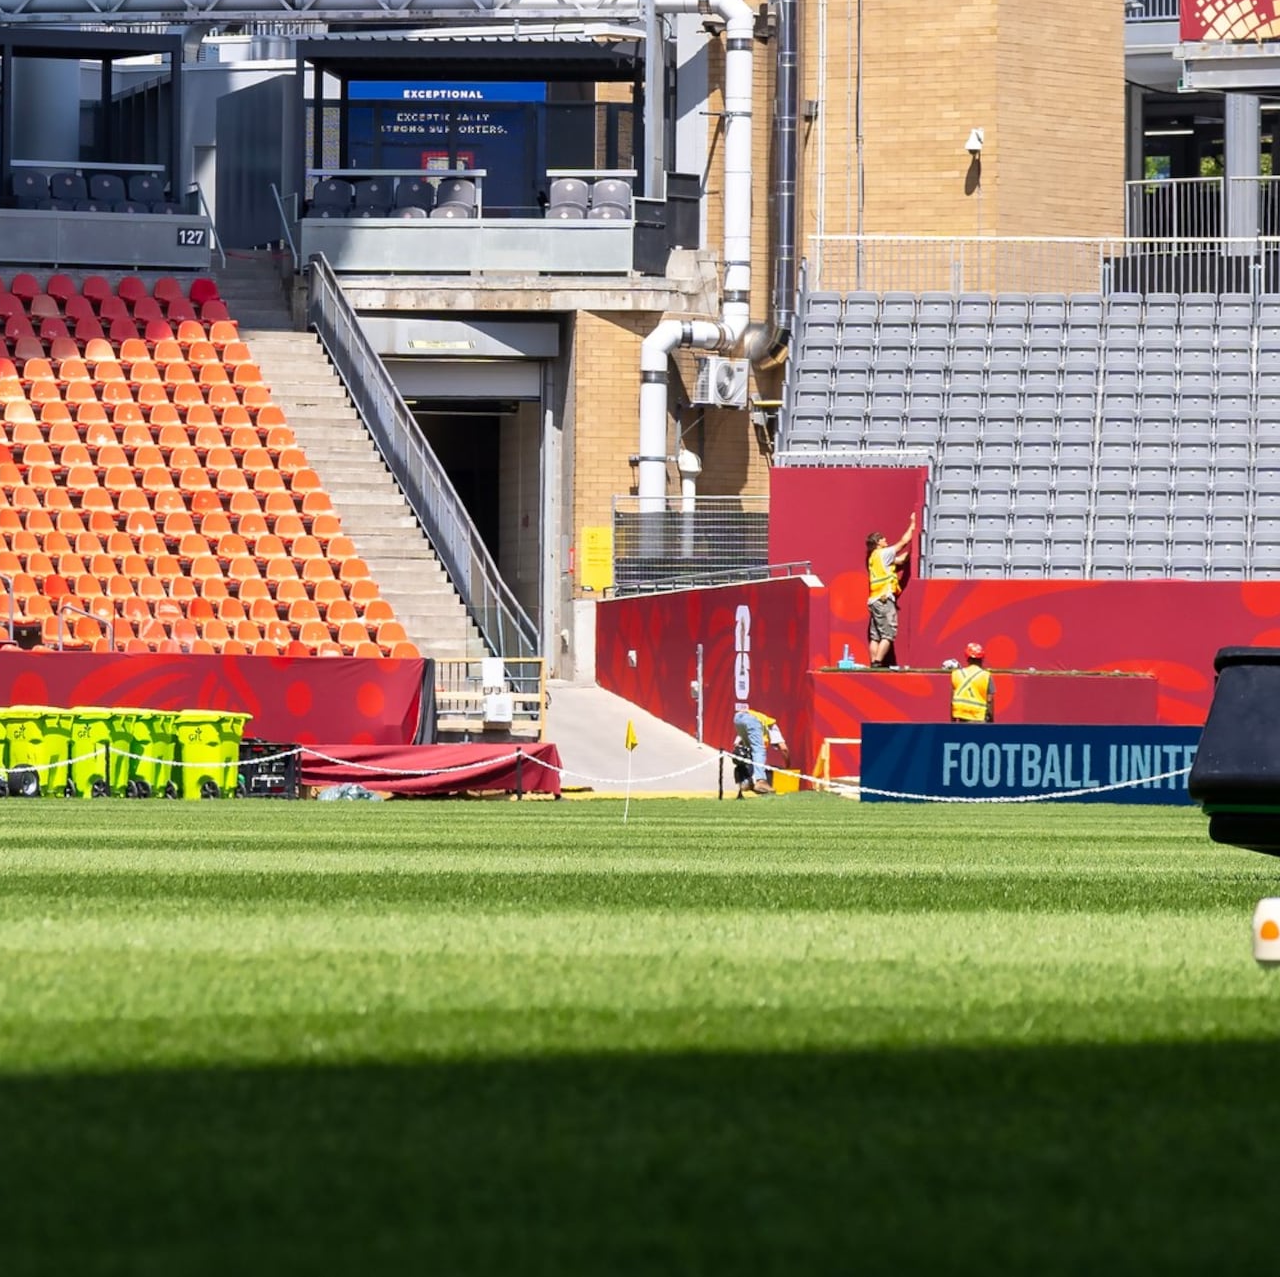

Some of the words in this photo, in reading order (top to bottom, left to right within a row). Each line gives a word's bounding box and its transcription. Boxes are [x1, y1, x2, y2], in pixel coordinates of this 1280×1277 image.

[403, 89, 483, 99] EXCEPTIONAL
[179, 230, 203, 244] 127
[943, 743, 1100, 788] FOOTBALL
